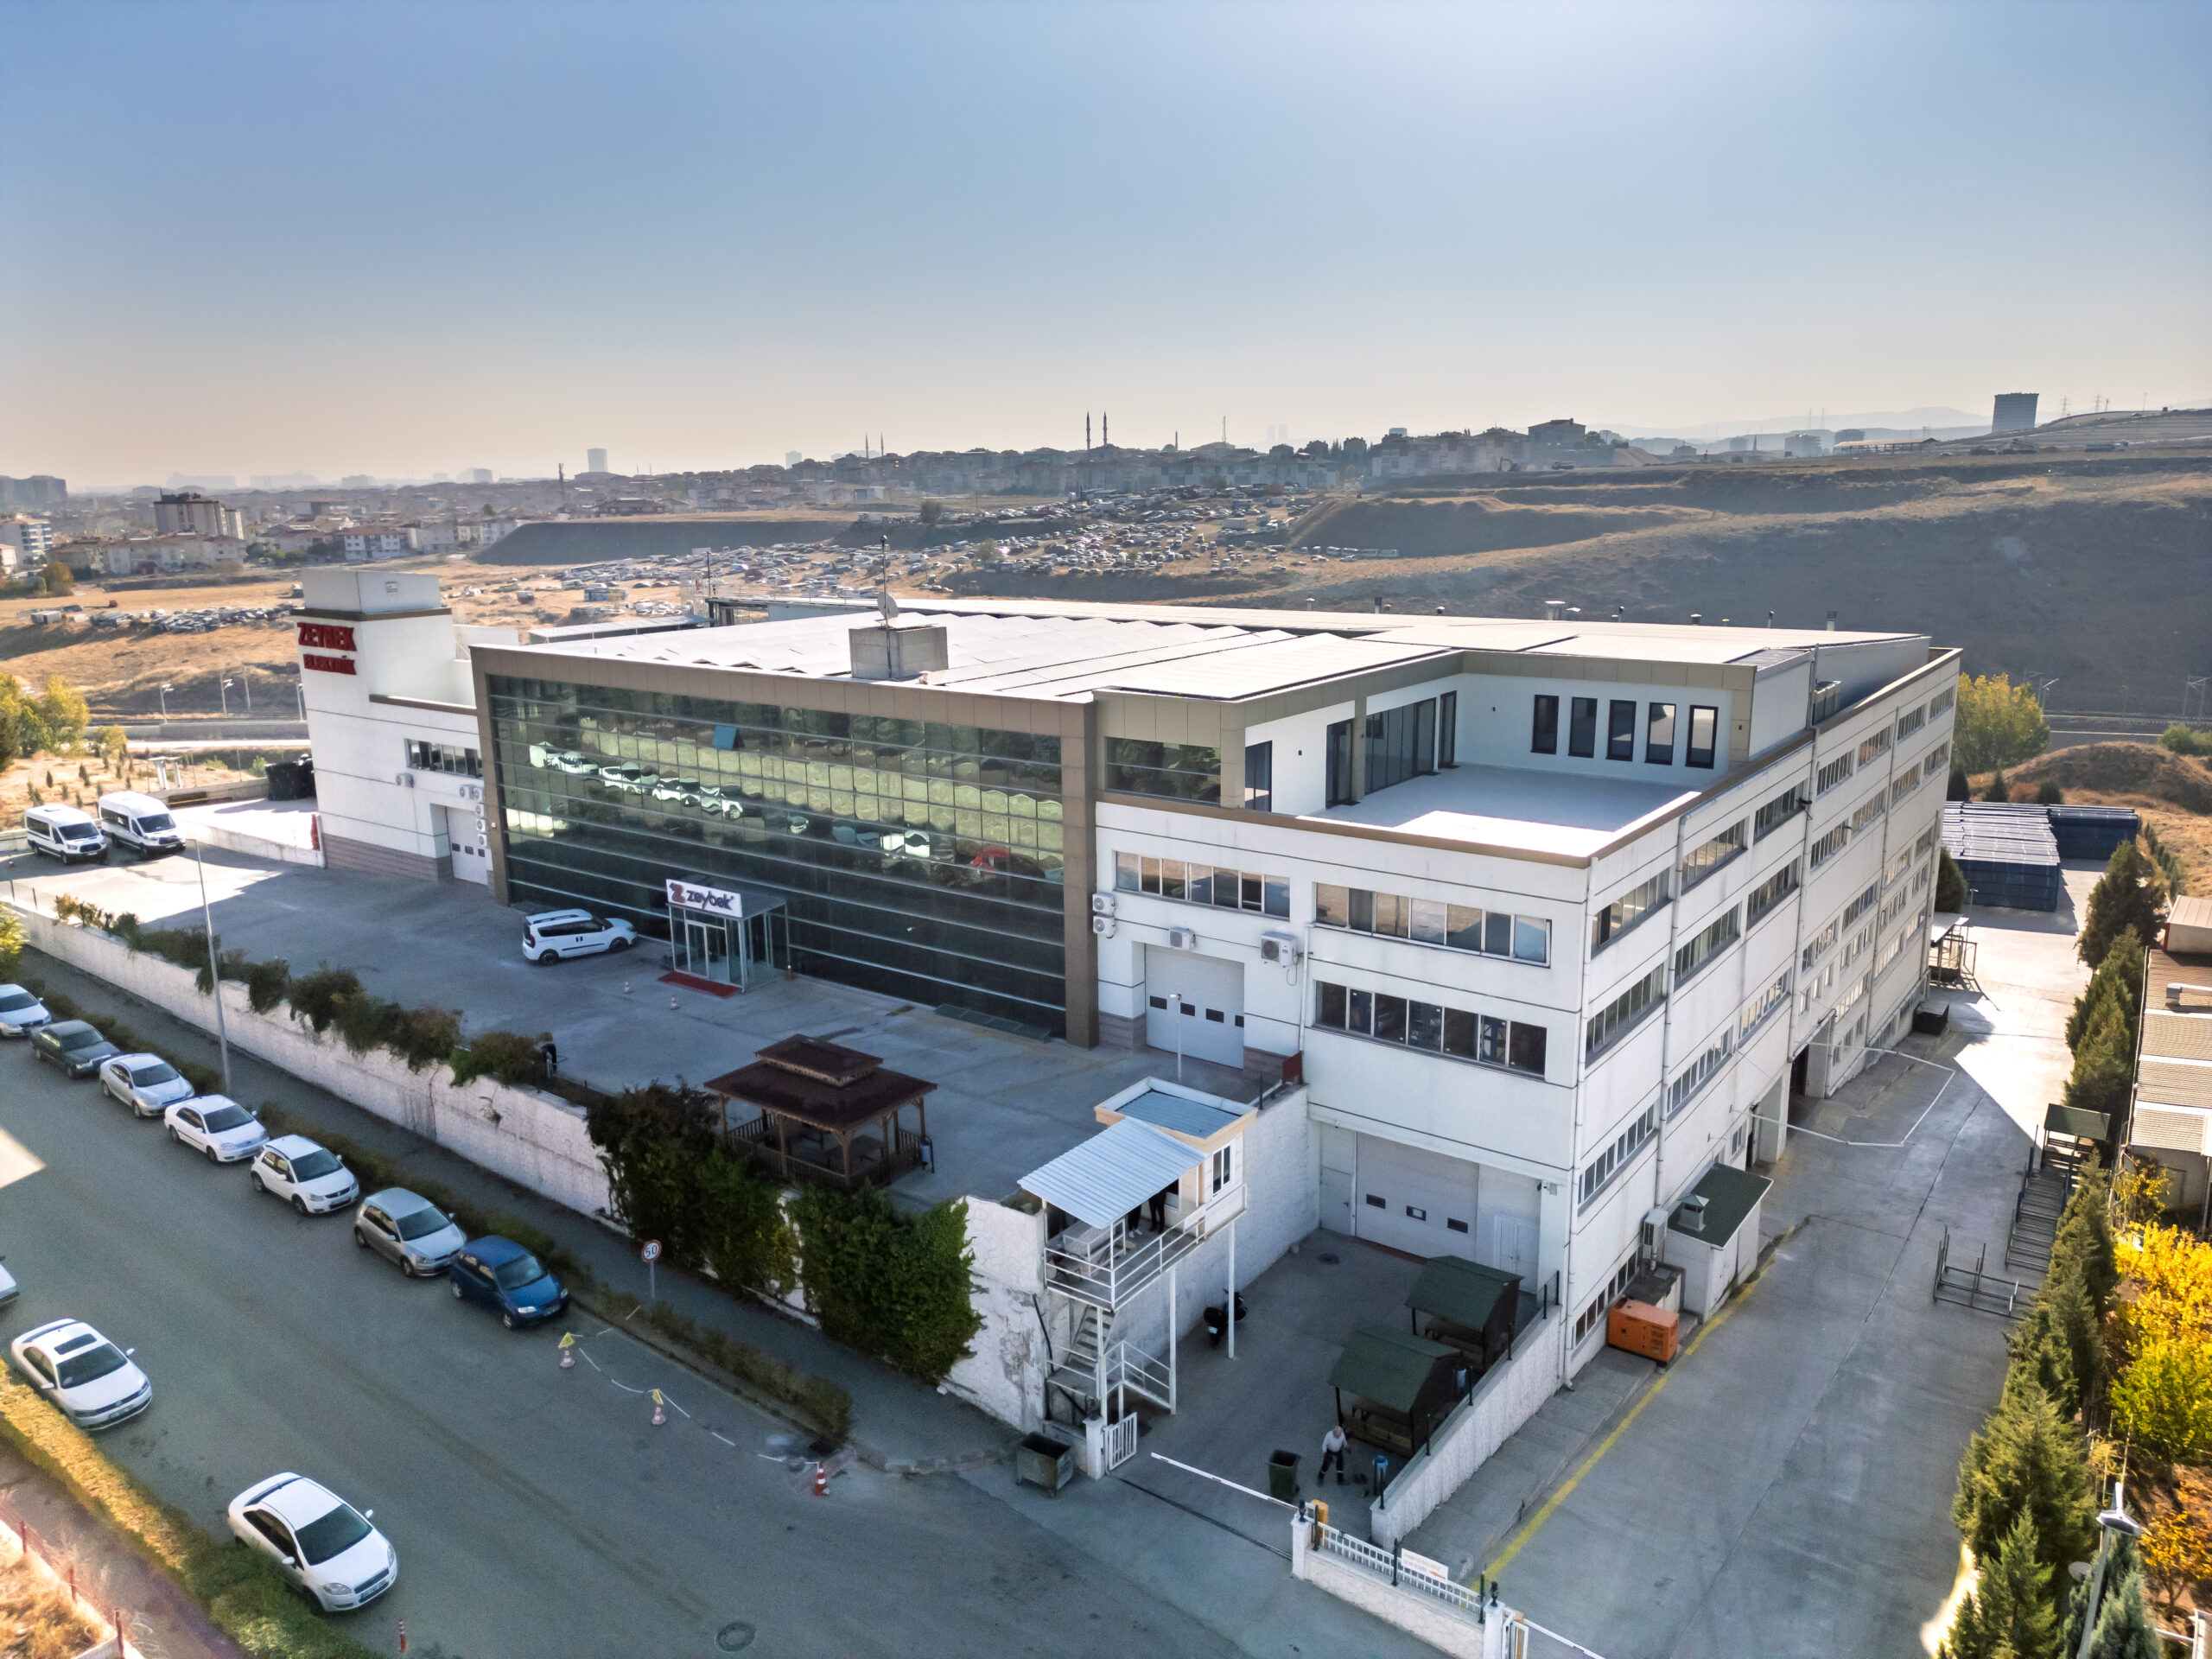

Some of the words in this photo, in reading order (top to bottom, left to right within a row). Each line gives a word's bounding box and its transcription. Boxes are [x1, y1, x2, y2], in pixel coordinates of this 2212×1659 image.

[297, 622, 358, 652] ZEYBEK
[686, 890, 734, 911] zeybek
[645, 1244, 657, 1258] 50
